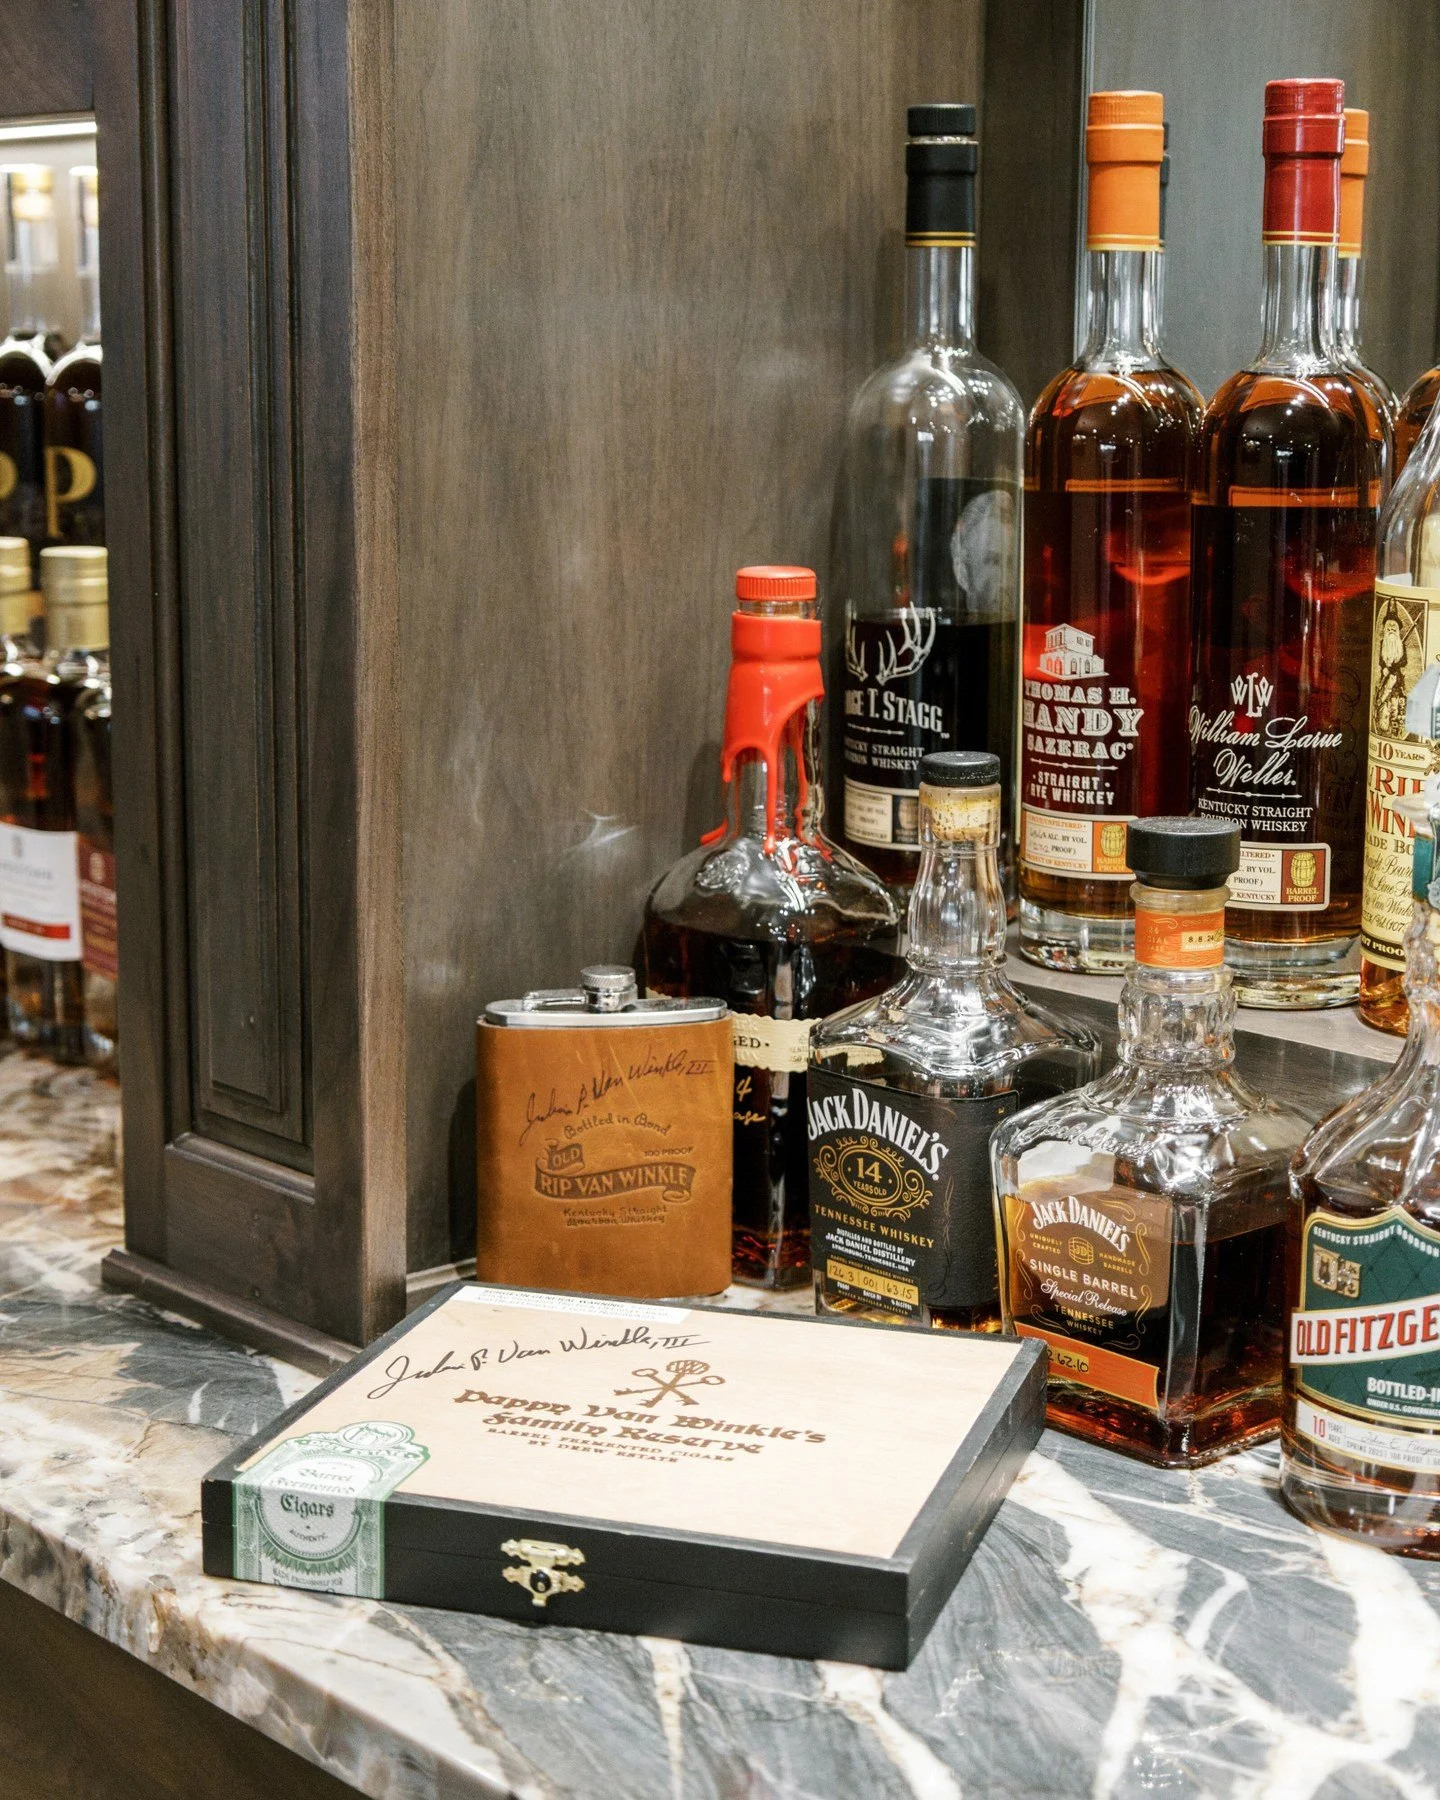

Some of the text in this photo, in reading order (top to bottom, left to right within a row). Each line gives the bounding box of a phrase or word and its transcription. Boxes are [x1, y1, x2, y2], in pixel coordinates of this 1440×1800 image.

[1024, 679, 1137, 704] THOMAS H.
[883, 691, 943, 733] STAGG
[1023, 699, 1144, 737] HANDY
[1188, 705, 1343, 753] William Larue
[871, 744, 925, 758] STRAIGHT
[1377, 742, 1394, 760] 10
[1395, 748, 1426, 761] YEARS
[871, 756, 920, 771] WHISKEY
[1030, 784, 1115, 806] RYE WHISKEY
[1198, 798, 1313, 818] KENTUCKY STRAIGHT
[1251, 820, 1308, 832] WHISKEY
[1258, 866, 1276, 874] VOL.
[1236, 891, 1277, 901] KENTUCKY
[1286, 887, 1319, 895] BARREL
[1372, 941, 1405, 957] PROO
[564, 1112, 672, 1140] Bottled in Bond
[807, 1095, 853, 1141] JACK
[553, 1148, 580, 1167] OLD
[661, 1146, 694, 1156] PROOF
[541, 1165, 688, 1194] RIP VAN WINKLE
[856, 1157, 882, 1183] 14
[853, 1180, 887, 1196] YEARS OLD
[563, 1204, 668, 1220] Kentucky Straight
[1030, 1198, 1070, 1231] JACK
[815, 1204, 935, 1249] TENNESSEE WHISKEY
[825, 1232, 916, 1267] JACK DANIEL DISTILLERY
[836, 1227, 905, 1254] DISTILLED AND BOTTLED BY
[1029, 1232, 1063, 1246] UNIQUELY
[1032, 1242, 1061, 1255] CRAFTED
[1313, 1225, 1440, 1258] KENTUCKY STRAIGHT BOURBON
[897, 1263, 910, 1272] USA
[1099, 1252, 1137, 1268] HANDMADE
[1103, 1262, 1134, 1275] BARRELS
[1029, 1258, 1138, 1300] SINGLE BARREL
[886, 1282, 914, 1300] 63.15
[1040, 1278, 1128, 1317] Special Release
[1054, 1304, 1114, 1330] TENNESSEE
[1066, 1320, 1104, 1336] WHISKEY
[1296, 1303, 1440, 1356] OLD FITZGE
[499, 1341, 551, 1364] Van
[453, 1389, 827, 1443] Pappy Van Winkle's
[1366, 1398, 1440, 1417] UNDER U.S. GOVERNME
[482, 1412, 765, 1454] Family Reserve
[1313, 1415, 1326, 1438] 10
[1328, 1422, 1342, 1434] YEARS
[487, 1428, 735, 1462] BARREL FERMENTED CIGARS
[1328, 1434, 1340, 1445] AGED
[527, 1439, 679, 1463] BY DREW ESTATE
[280, 1492, 334, 1518] Cigars
